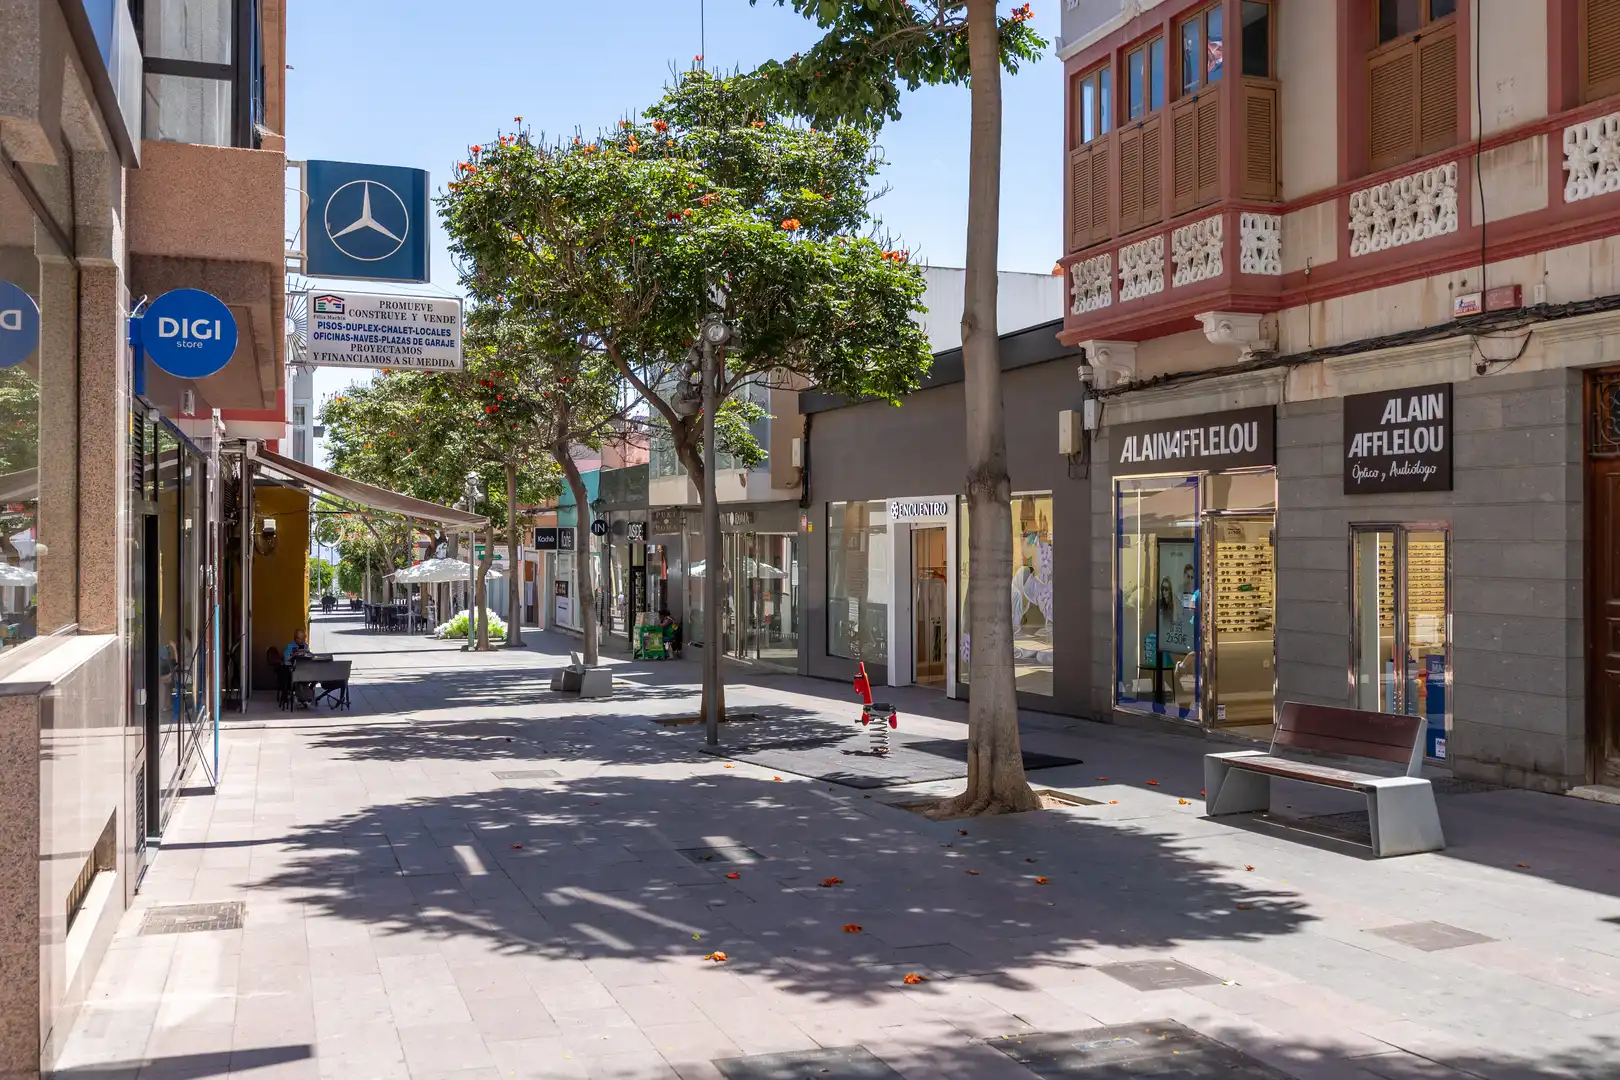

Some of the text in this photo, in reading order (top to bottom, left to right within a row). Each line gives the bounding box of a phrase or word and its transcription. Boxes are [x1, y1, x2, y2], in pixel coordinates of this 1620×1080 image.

[379, 300, 433, 312] PROMUEVE
[349, 309, 456, 324] CONSTRUYE Y VENDE
[158, 317, 221, 340] DIGI
[176, 340, 203, 348] store
[350, 343, 423, 355] PROYECTAMOS
[412, 338, 423, 346] DE
[424, 338, 455, 348] GARAJE
[312, 352, 455, 367] Y FINANCIAMOS A SU MEDIDA
[1380, 392, 1444, 424] ALAIN
[1348, 425, 1444, 458] AFFLELOU
[1389, 460, 1437, 482] Audiólogo
[899, 502, 948, 517] ENCUENTRO
[594, 523, 605, 532] IN
